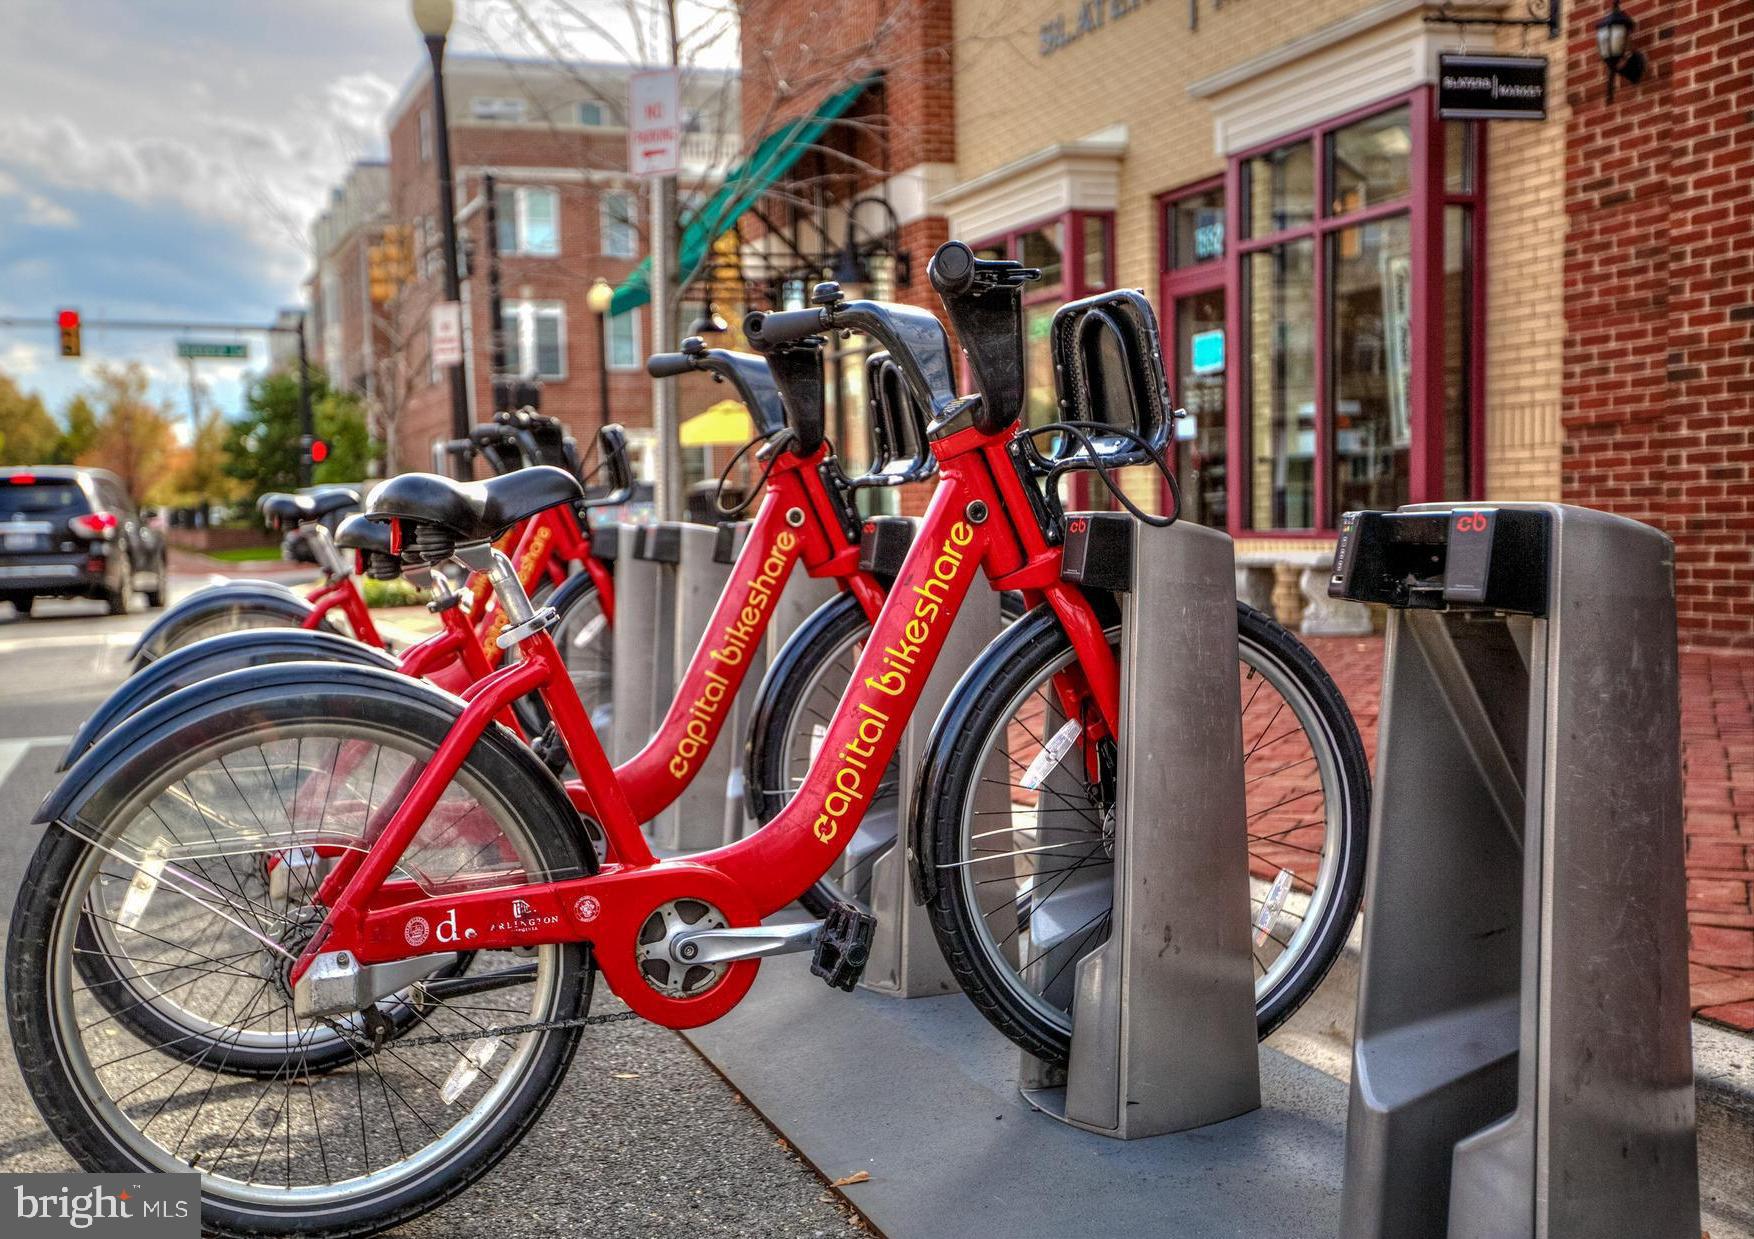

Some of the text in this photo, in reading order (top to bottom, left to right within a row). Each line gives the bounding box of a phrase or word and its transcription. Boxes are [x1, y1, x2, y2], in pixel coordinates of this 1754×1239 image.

[1456, 511, 1488, 532] cb
[669, 530, 796, 780] capital bikeshare
[813, 521, 974, 845] capital bikeshare
